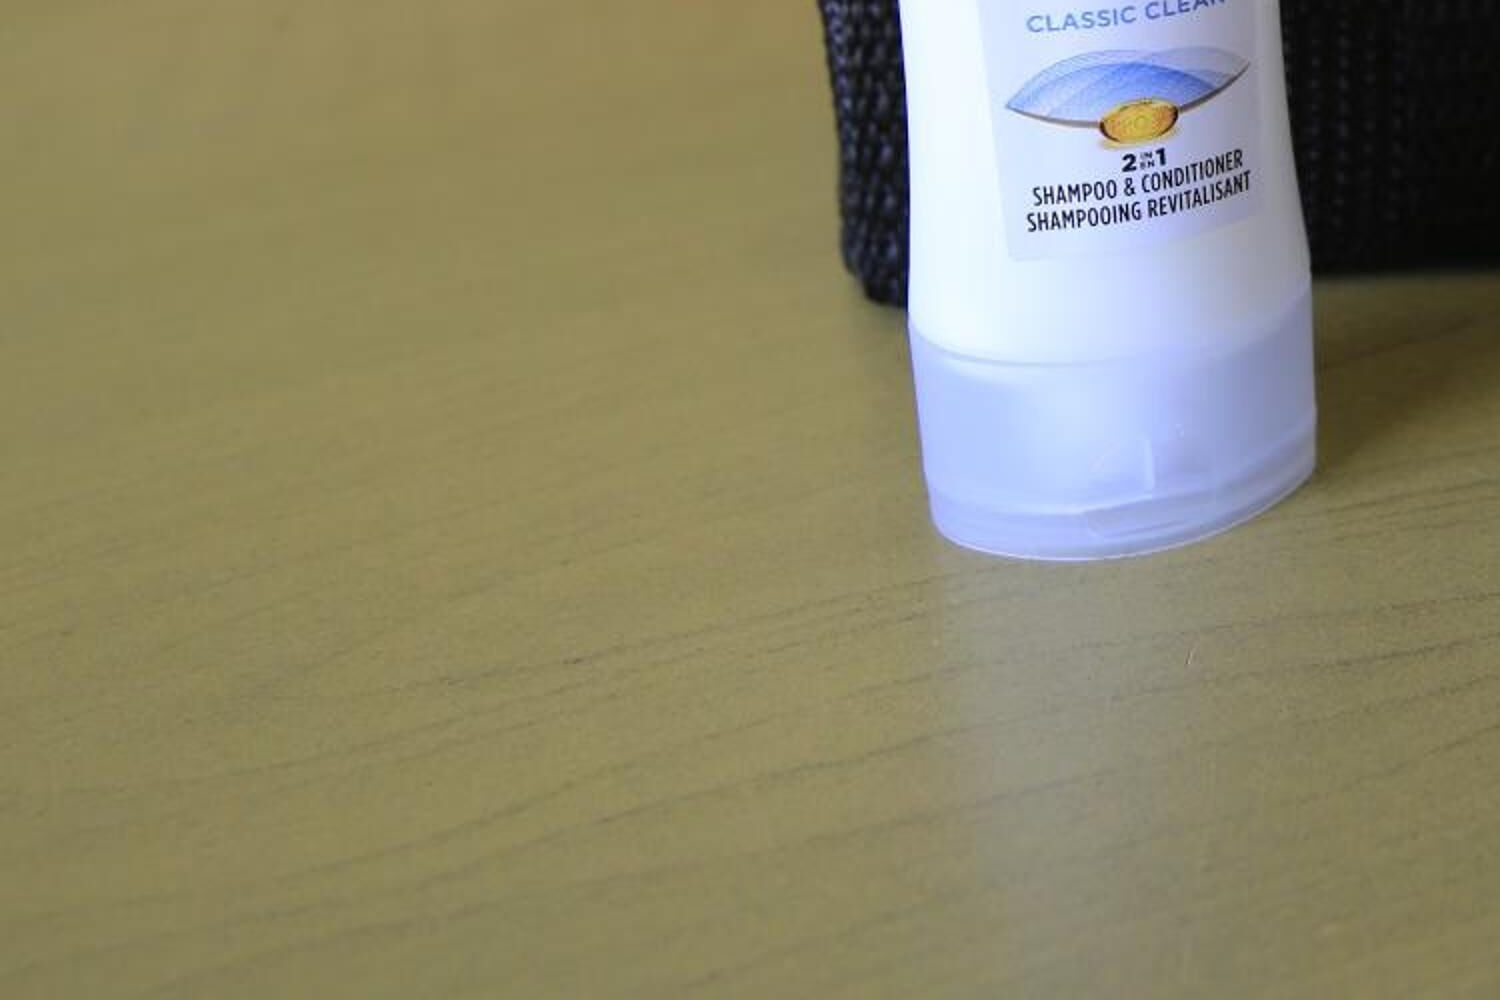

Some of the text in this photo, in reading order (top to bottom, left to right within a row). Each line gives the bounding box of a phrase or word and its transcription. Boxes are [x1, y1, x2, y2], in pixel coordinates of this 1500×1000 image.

[1026, 6, 1137, 33] CLASSIC
[1033, 149, 1243, 206] SHAMPOO & CONDITIONER
[1122, 153, 1137, 173] 2
[1155, 147, 1167, 167] 1
[1027, 170, 1251, 232] SHAMPOOING REVITALISANT
